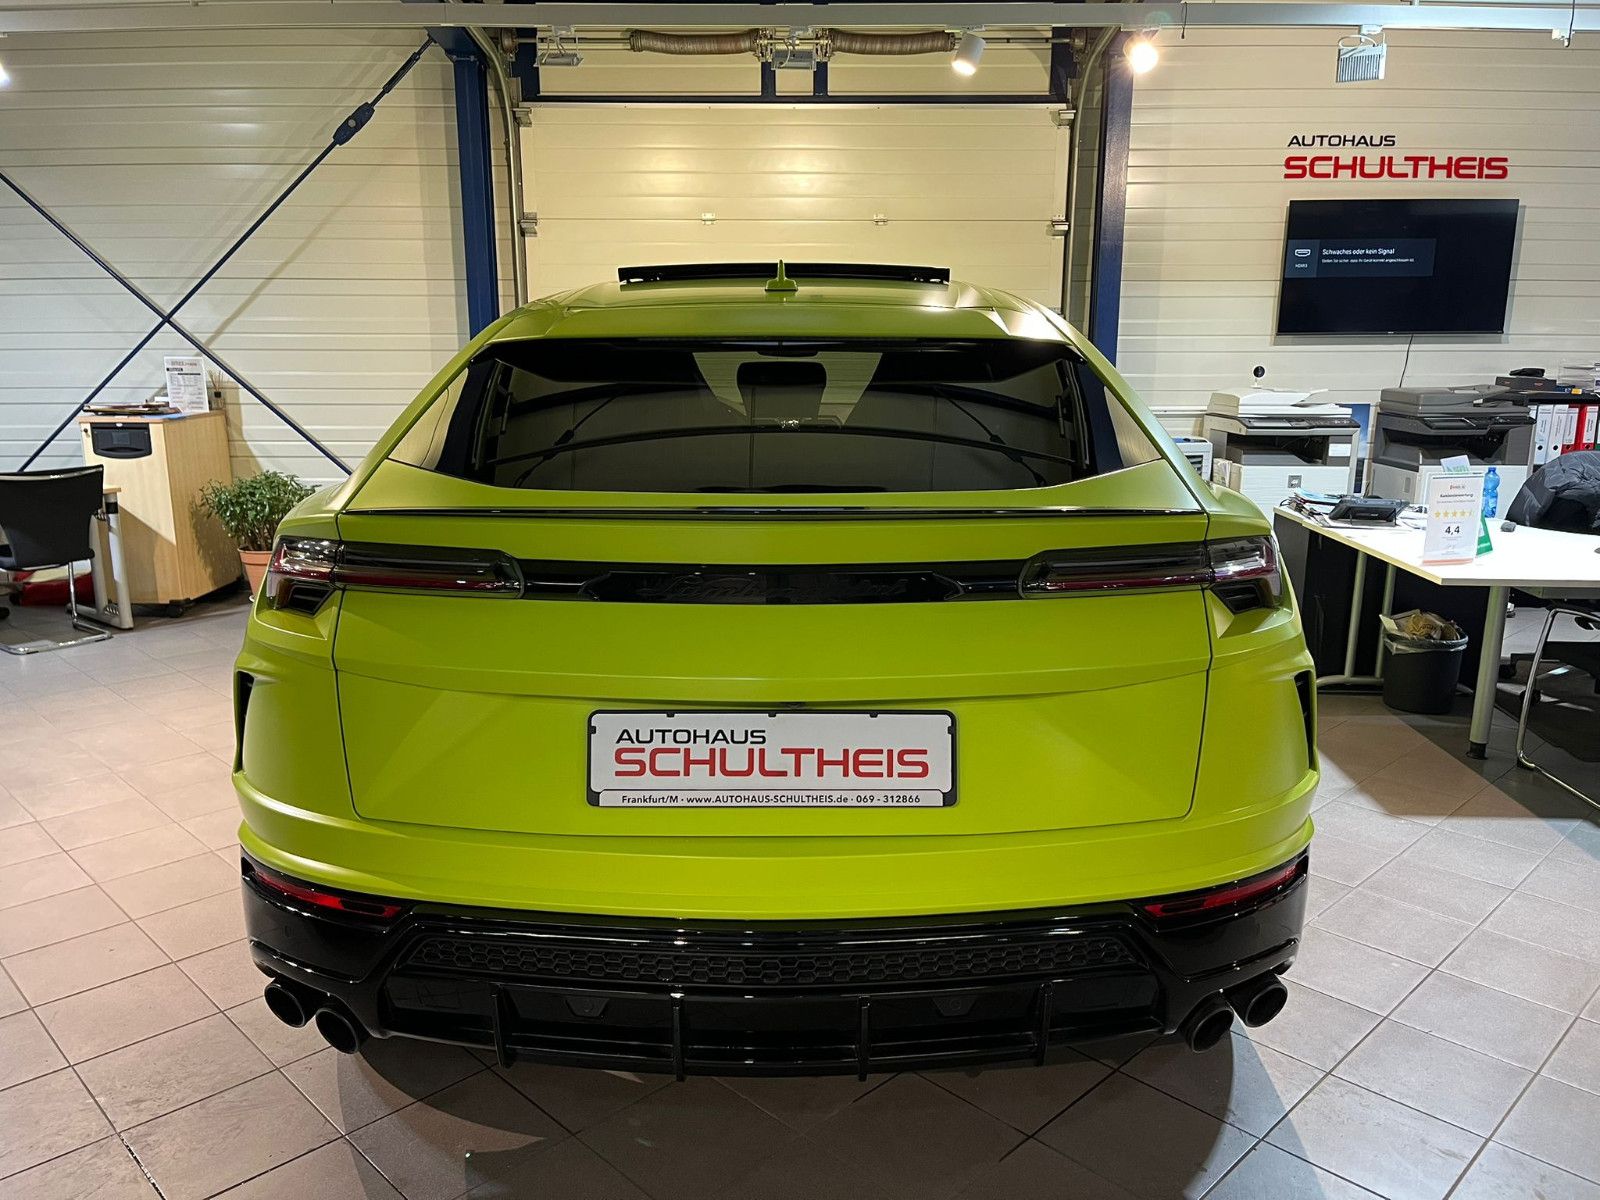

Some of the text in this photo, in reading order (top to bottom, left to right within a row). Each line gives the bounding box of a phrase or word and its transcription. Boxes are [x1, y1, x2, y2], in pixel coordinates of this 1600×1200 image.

[1288, 134, 1396, 147] AUTOHAUS
[1284, 156, 1509, 179] SCHULTHEIS
[1322, 247, 1352, 256] Schwaches
[1377, 247, 1395, 256] Signal
[1444, 525, 1460, 535] 4,4
[615, 728, 767, 745] AUTOHAUS
[614, 747, 929, 778] SCHULTHEIS
[621, 794, 679, 804] Frankfurt/M
[686, 794, 849, 804] www.AUTOHAUS-SCHULTHEIS.de
[856, 794, 875, 804] 069
[883, 794, 921, 804] 312866
